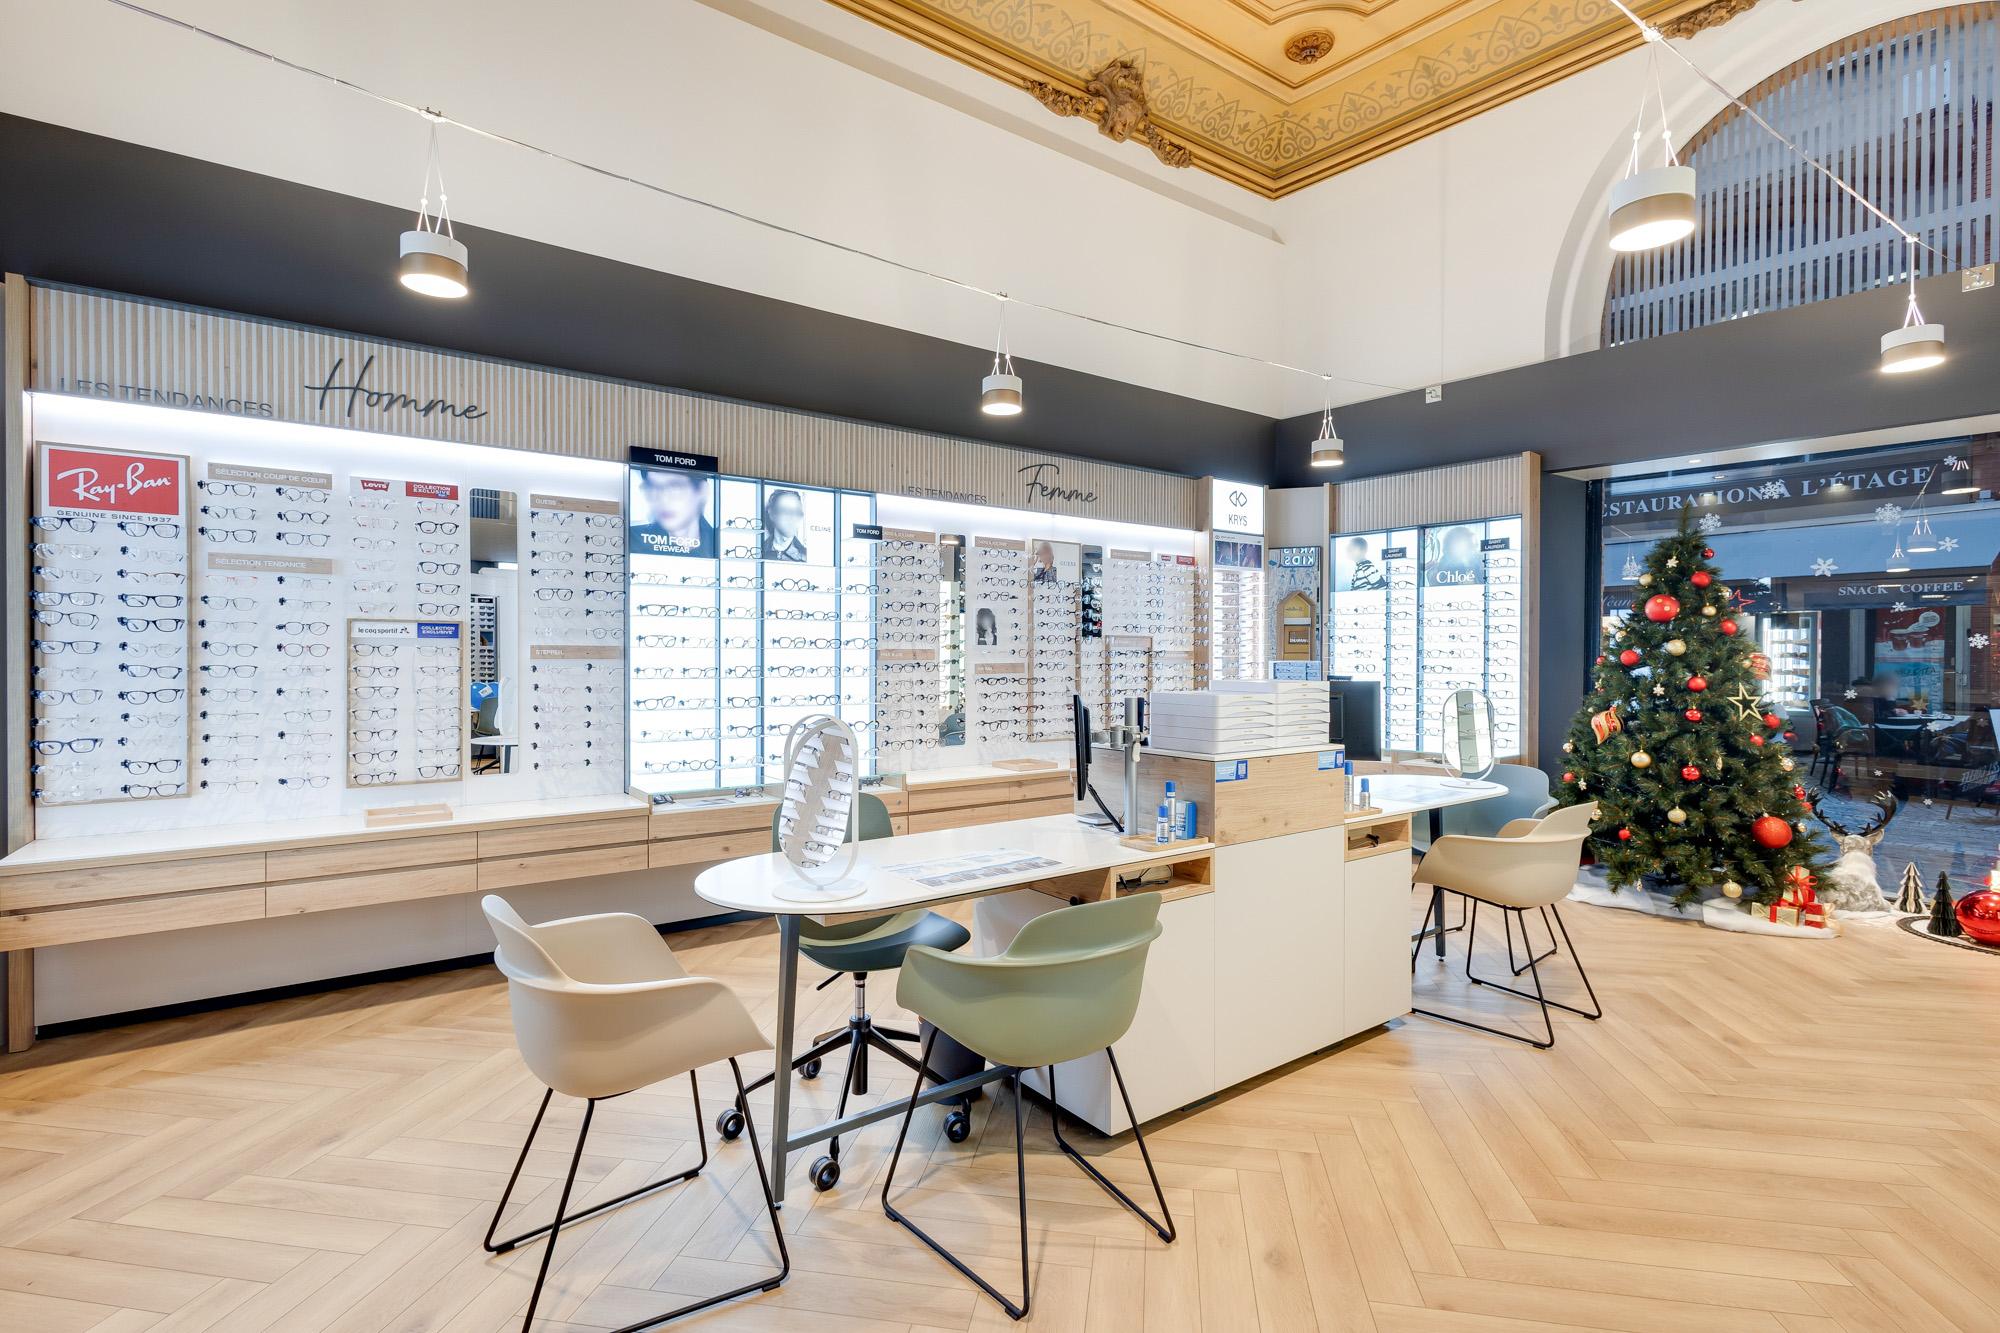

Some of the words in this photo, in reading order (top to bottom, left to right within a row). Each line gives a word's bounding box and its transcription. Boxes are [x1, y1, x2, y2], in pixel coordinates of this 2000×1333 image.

[304, 355, 488, 420] Homme
[60, 377, 110, 398] LES
[119, 384, 273, 418] TENDANCES
[654, 454, 673, 464] TOM
[674, 457, 697, 466] FORD
[263, 472, 287, 480] COUP
[288, 474, 300, 482] DE
[1018, 463, 1098, 504] Femme
[901, 485, 922, 497] LES
[924, 487, 988, 505] TENDANCES
[56, 509, 107, 519] GENUINE
[111, 513, 144, 521] SINCE
[1228, 513, 1248, 526] KRYS
[640, 533, 668, 545] TOM
[668, 536, 701, 548] FORD
[653, 544, 690, 553] EYEWEAR
[264, 560, 306, 569] TENDANCE
[1436, 570, 1475, 584] Chloé
[1838, 585, 1889, 596] SNACK
[1900, 581, 1964, 593] COFFEE
